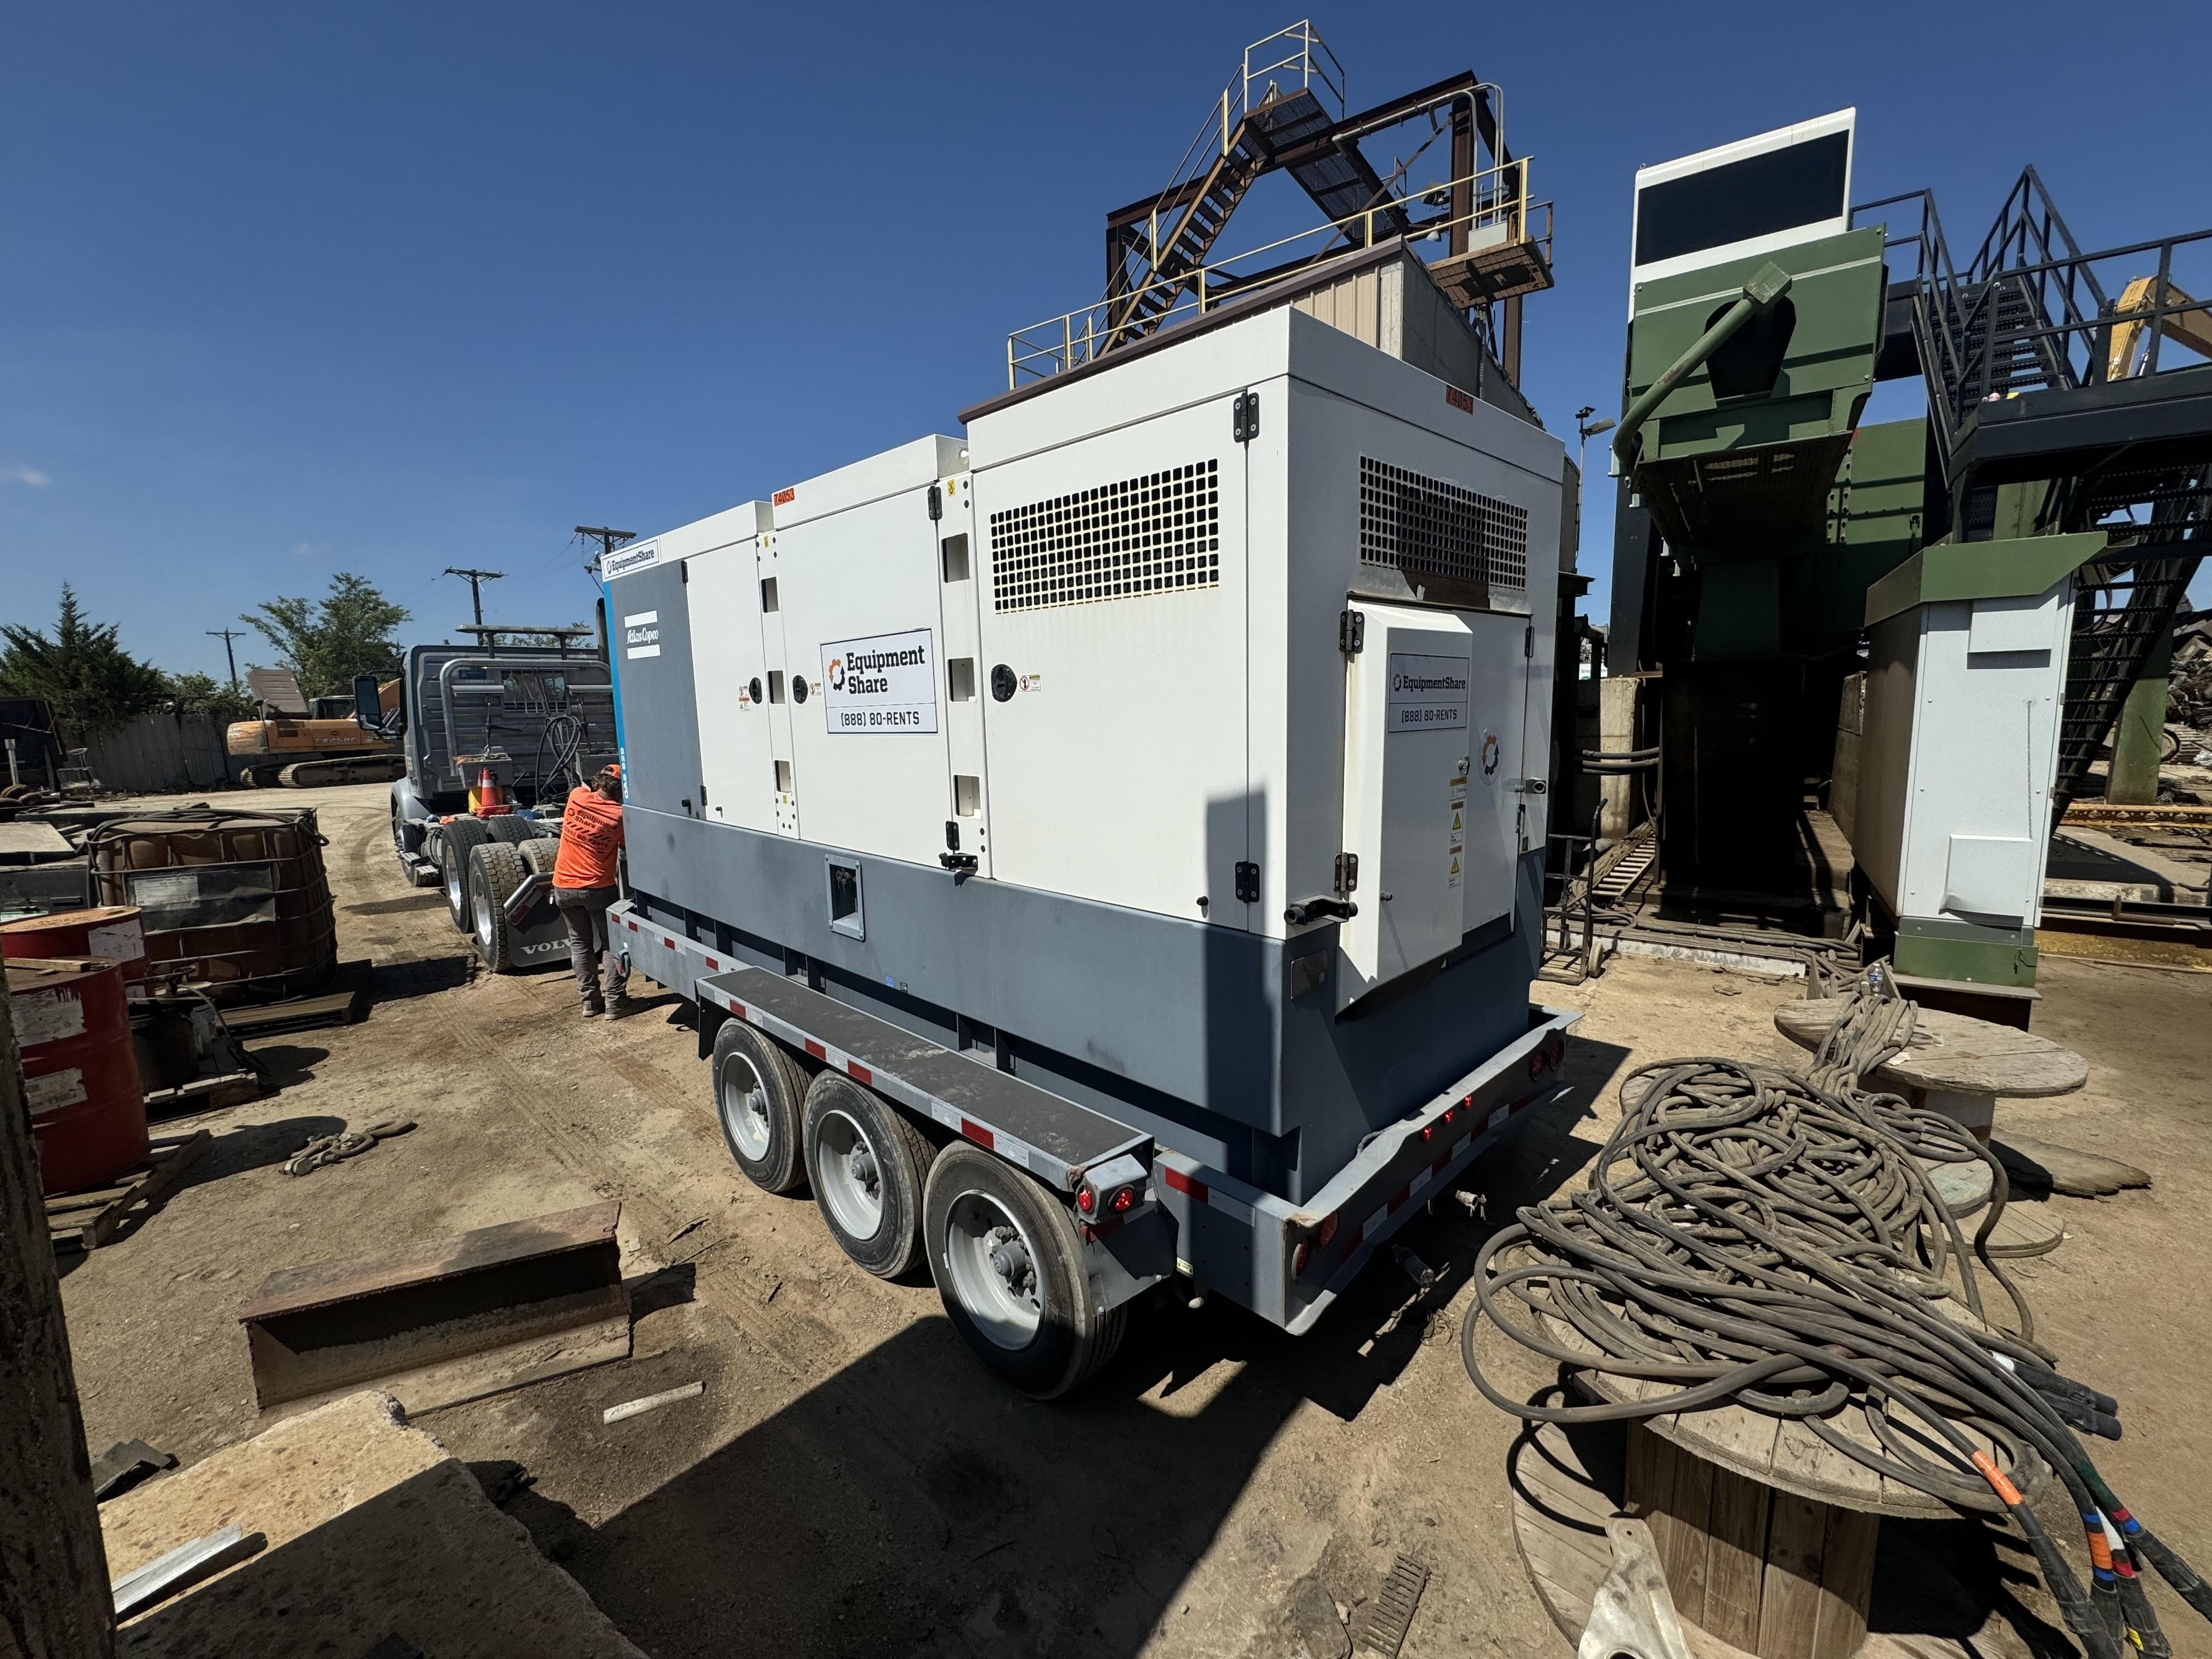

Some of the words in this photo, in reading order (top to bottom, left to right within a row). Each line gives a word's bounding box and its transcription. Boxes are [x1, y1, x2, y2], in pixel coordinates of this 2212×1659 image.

[774, 488, 795, 506] 74053
[612, 549, 654, 572] EquipmentShare
[627, 629, 642, 644] Atlas
[642, 627, 659, 644] Copco
[846, 645, 926, 674] Equipment
[848, 675, 888, 695] Share
[1402, 675, 1466, 692] EquipmentShare
[841, 712, 866, 727] (888)
[870, 711, 919, 725] 80-RENTS
[1401, 709, 1422, 723] (888)
[1424, 709, 1458, 721] 80-RENTS
[574, 815, 596, 829] Share
[520, 938, 571, 955] VOLV
